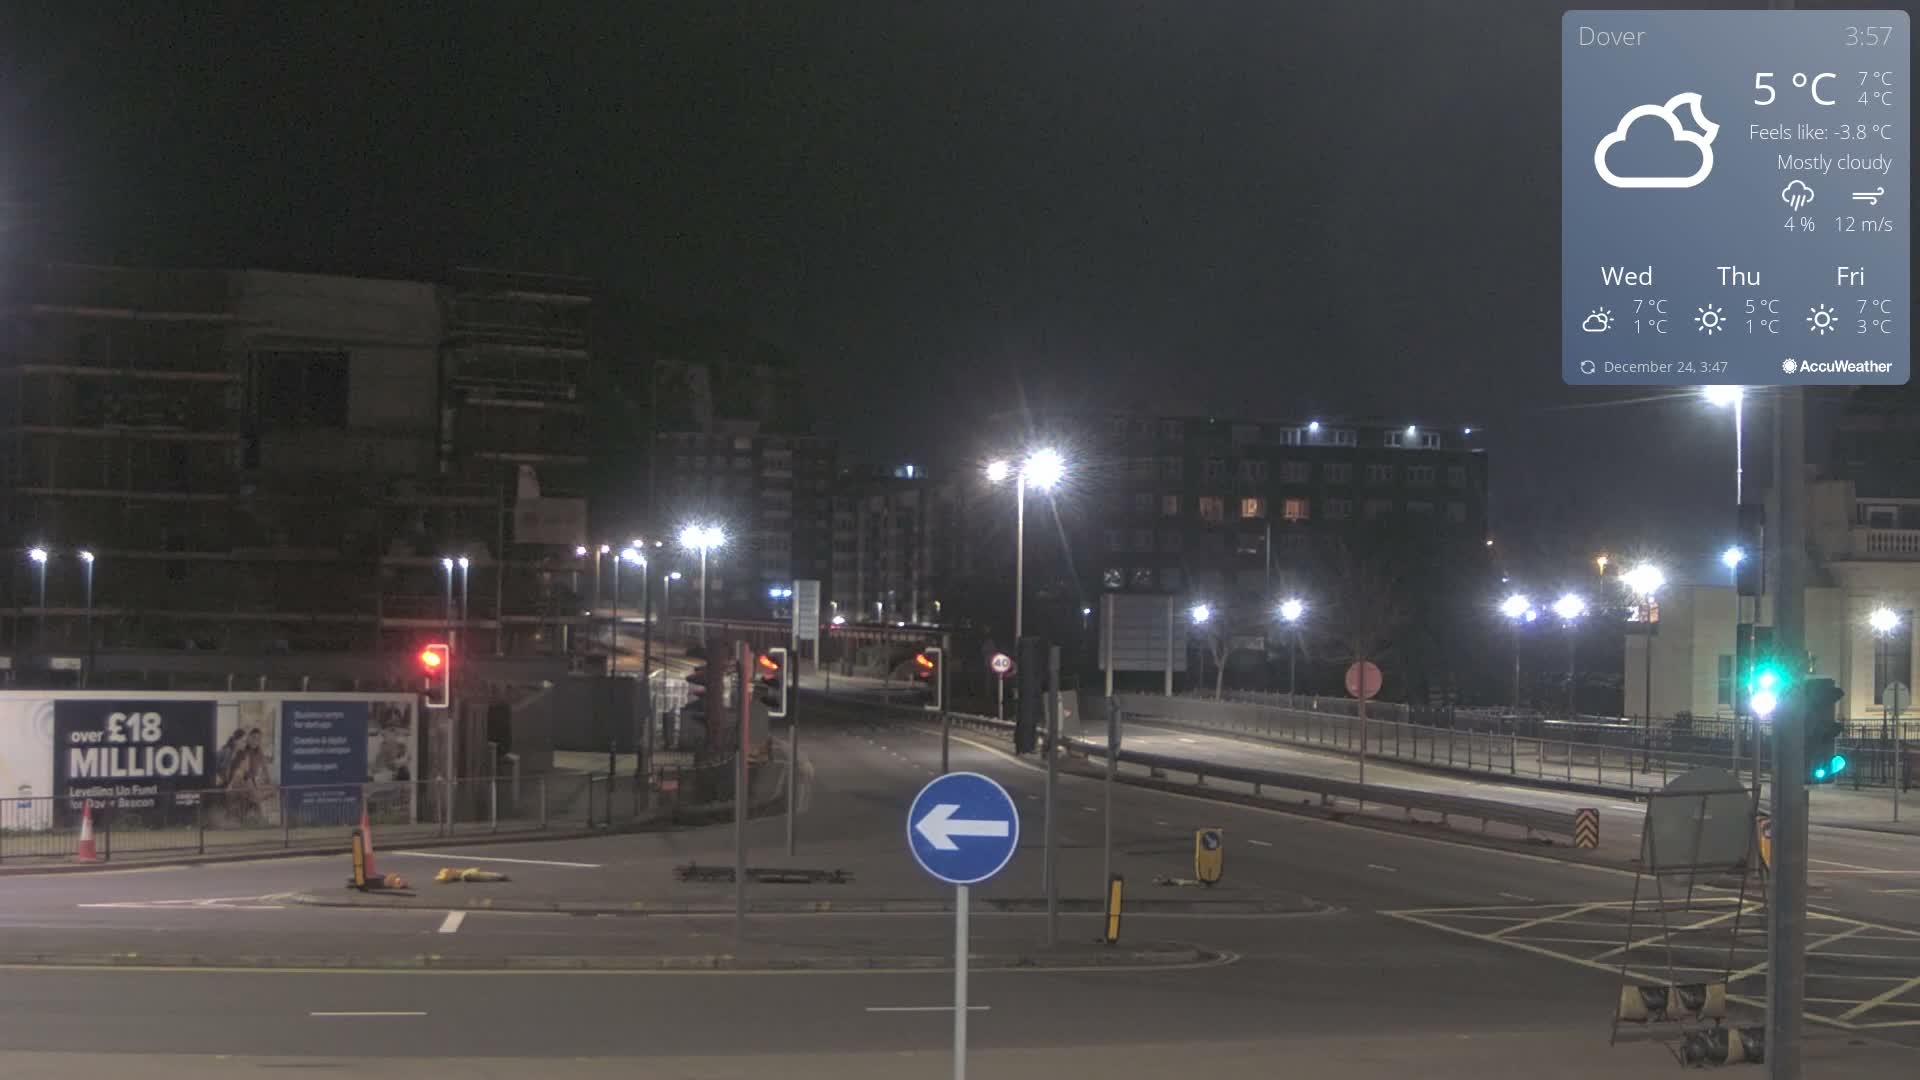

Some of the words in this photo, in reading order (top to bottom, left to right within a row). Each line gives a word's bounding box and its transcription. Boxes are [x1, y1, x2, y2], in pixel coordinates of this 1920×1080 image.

[994, 658, 1009, 668] 40
[71, 730, 104, 743] over
[108, 711, 162, 743] £18
[70, 745, 205, 778] MILLION
[132, 784, 158, 796] Fund
[117, 797, 155, 808] Beacon
